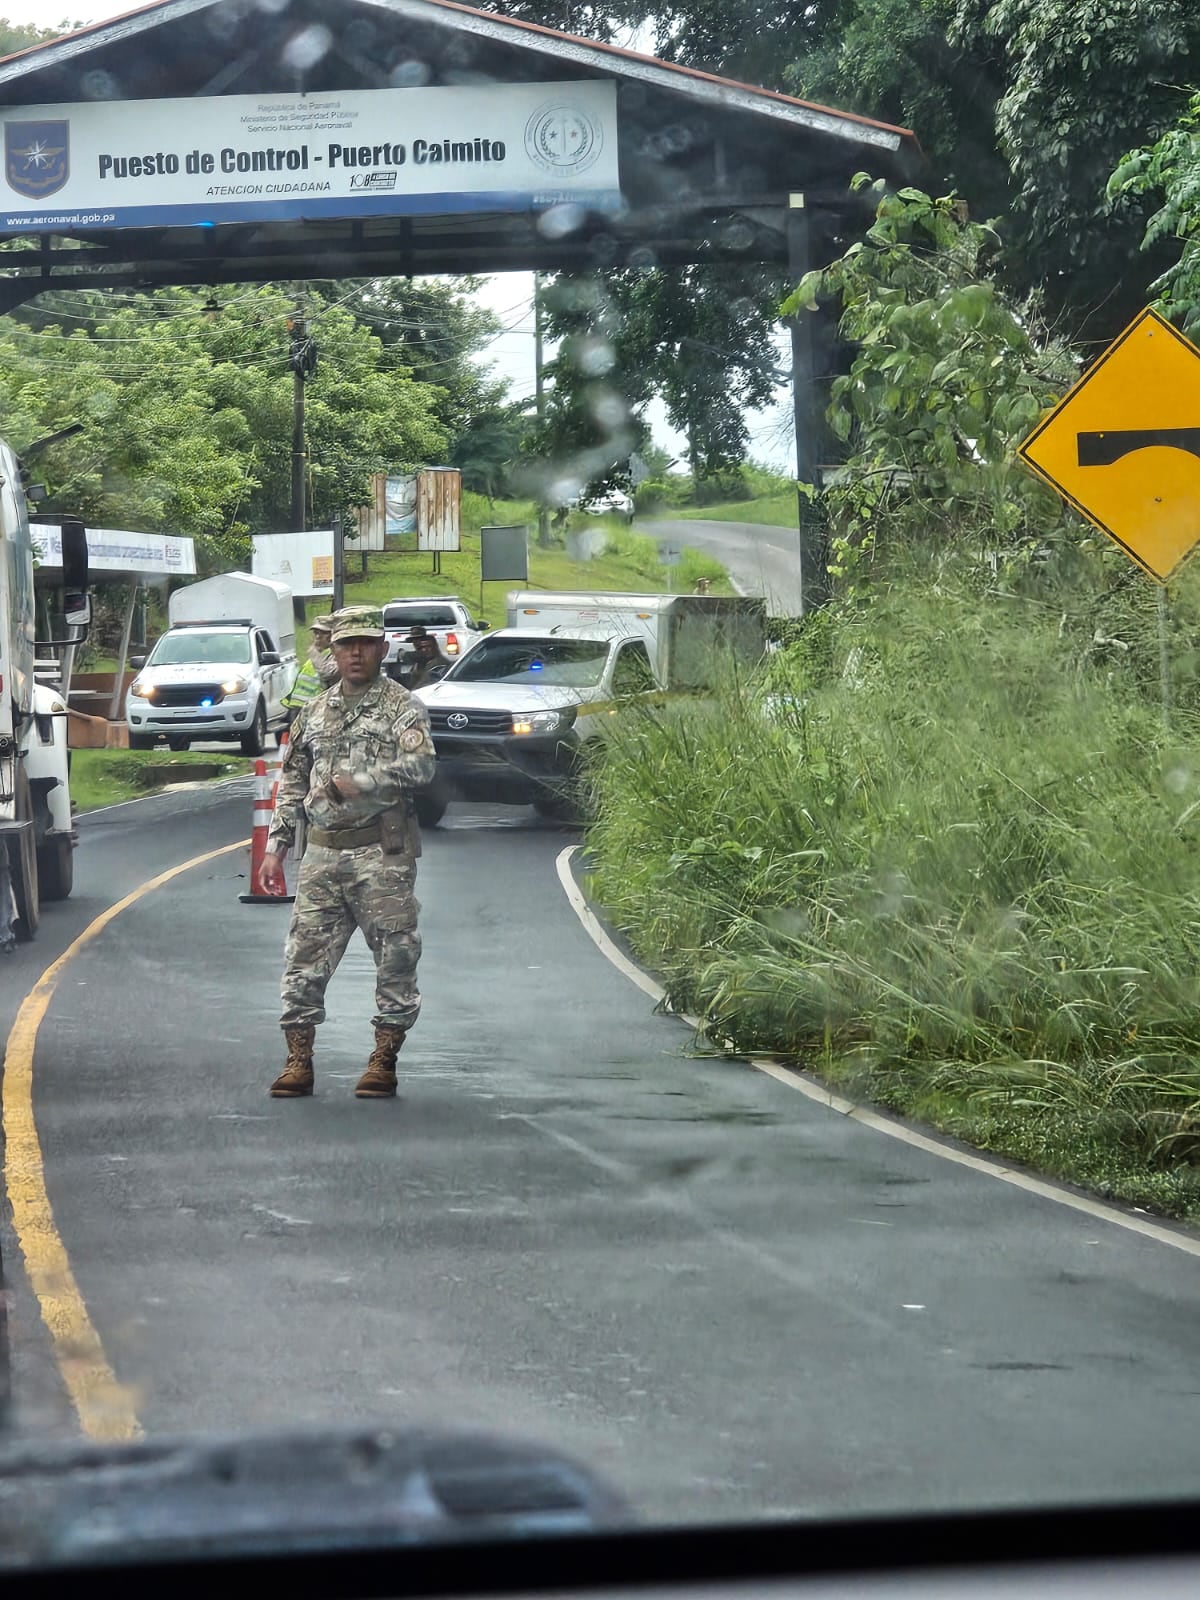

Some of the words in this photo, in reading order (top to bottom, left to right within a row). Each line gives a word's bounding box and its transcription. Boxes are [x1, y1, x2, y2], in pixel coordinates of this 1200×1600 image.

[290, 112, 329, 121] Seguridad
[248, 124, 278, 132] Servicio
[280, 123, 313, 131] Nacional
[314, 121, 353, 129] Aeronaval
[99, 153, 179, 179] Puesto
[185, 150, 215, 175] de
[220, 145, 309, 174] Control
[328, 142, 406, 168] Puerto
[412, 138, 506, 165] Caimito
[206, 184, 264, 196] ATENCION
[265, 181, 331, 194] CIUDADANA
[6, 213, 116, 226] www.aeronaval.gob.pa
